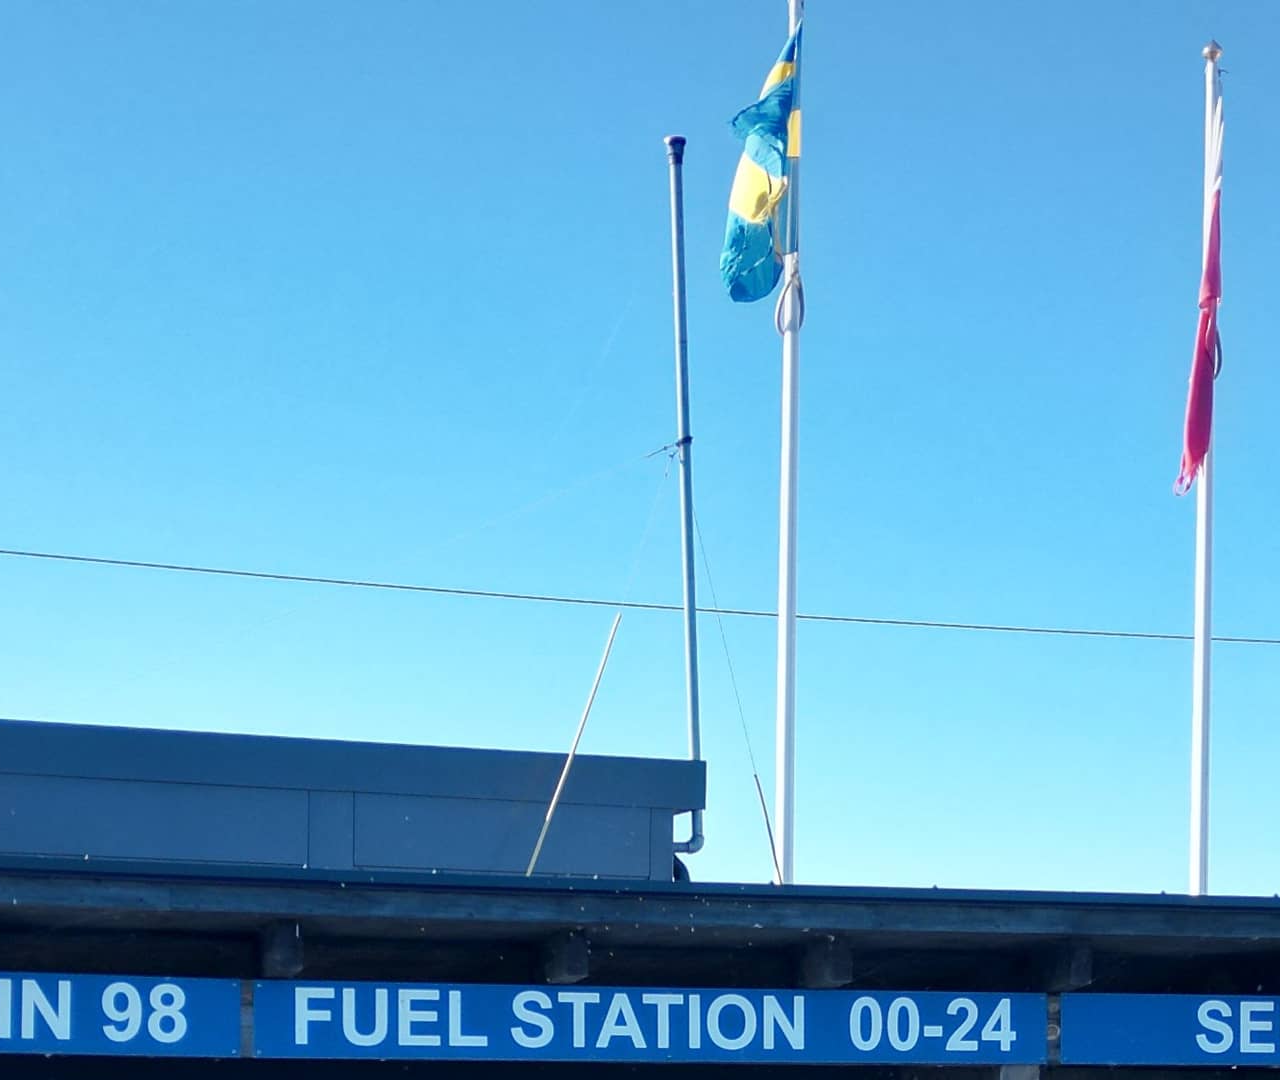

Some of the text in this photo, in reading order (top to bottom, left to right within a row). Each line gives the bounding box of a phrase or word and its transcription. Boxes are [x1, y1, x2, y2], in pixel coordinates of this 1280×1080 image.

[101, 981, 188, 1044] 98
[294, 987, 1018, 1053] FUEL STATION 00-24
